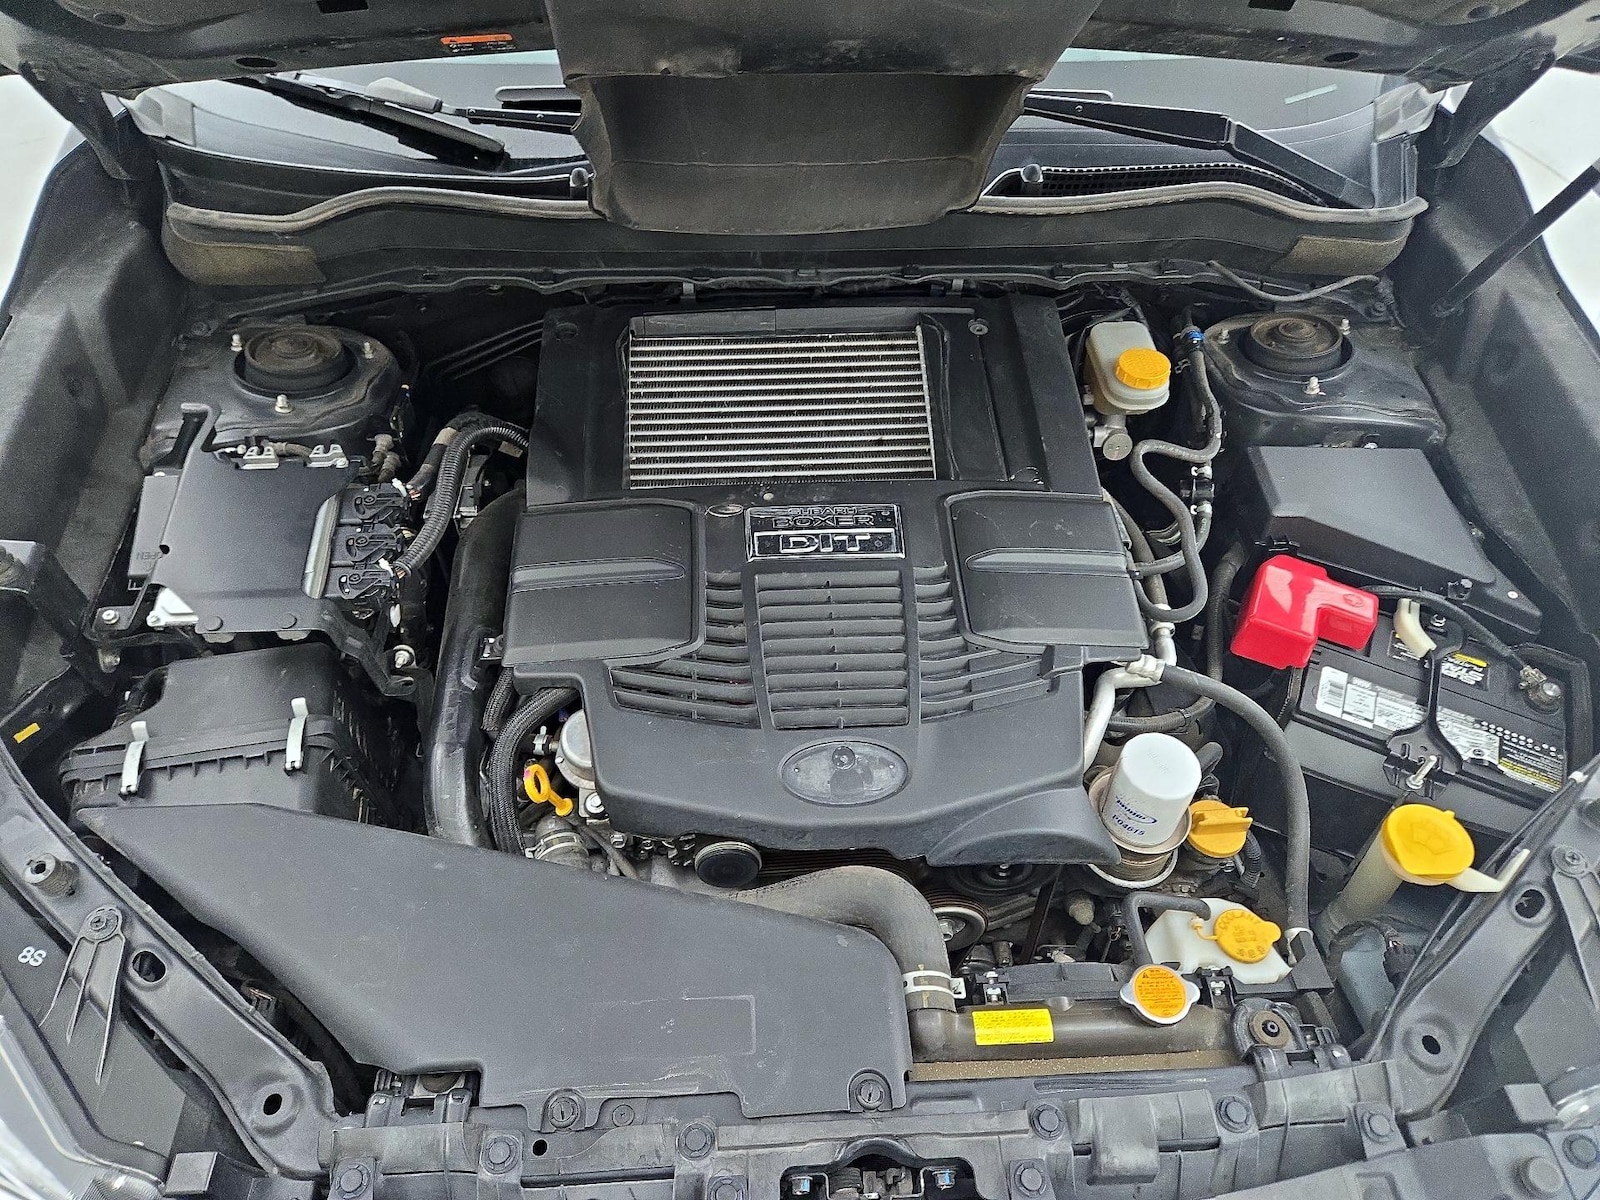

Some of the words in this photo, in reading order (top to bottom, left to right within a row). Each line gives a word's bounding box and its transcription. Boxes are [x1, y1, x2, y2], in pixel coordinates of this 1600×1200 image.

[787, 506, 857, 515] SUBARU
[772, 515, 875, 529] BOXER
[780, 533, 871, 553] DIT
[18, 946, 46, 966] 8S
